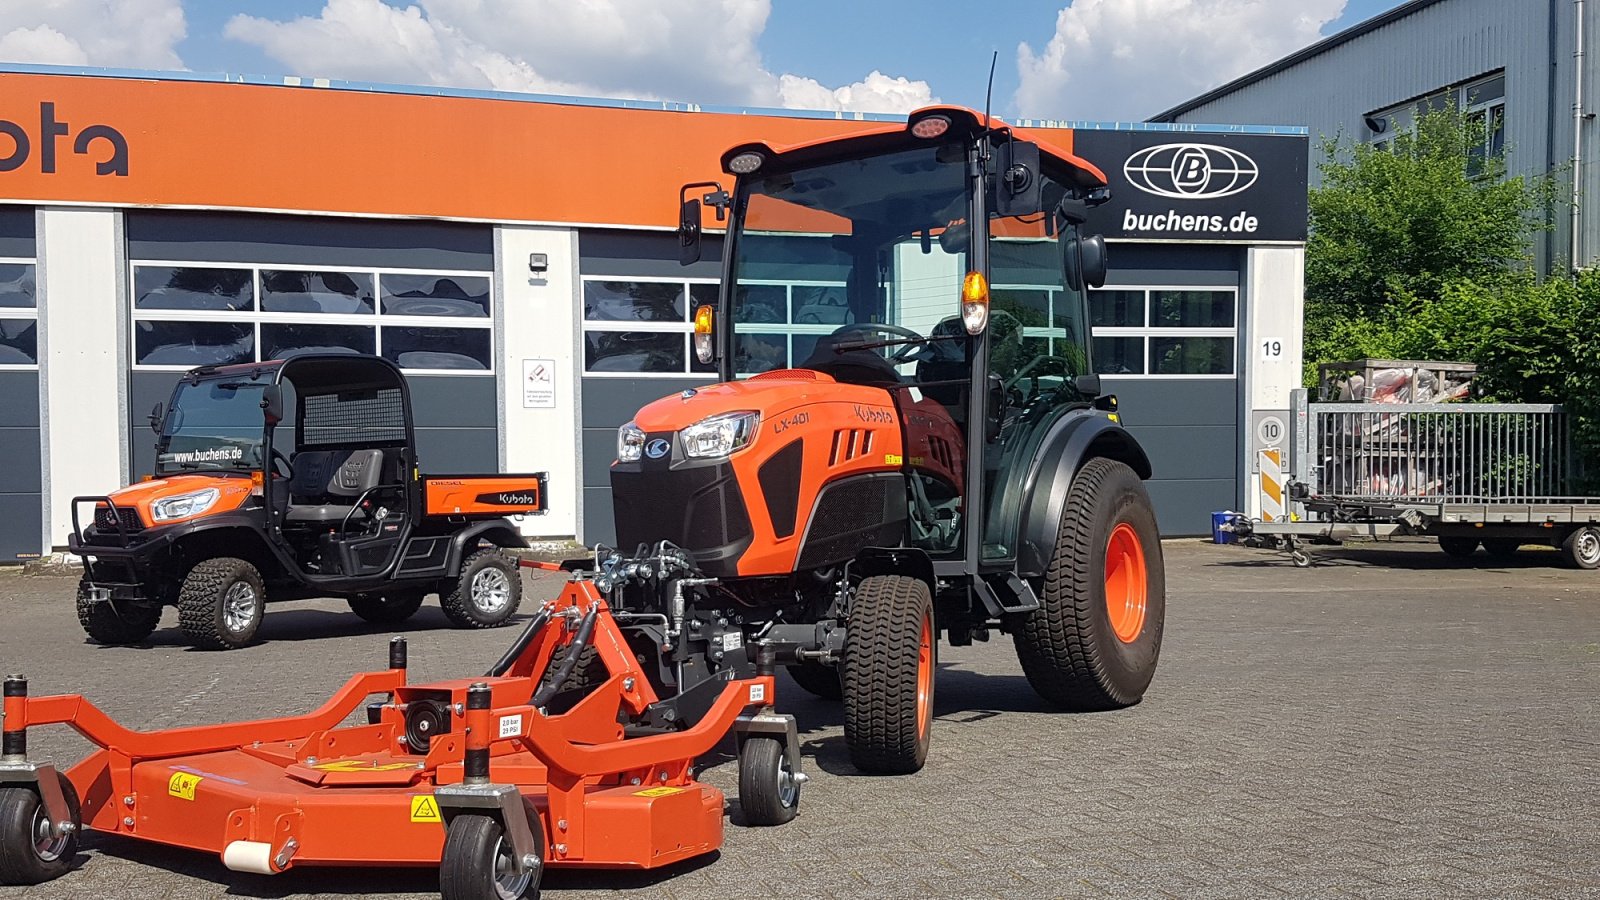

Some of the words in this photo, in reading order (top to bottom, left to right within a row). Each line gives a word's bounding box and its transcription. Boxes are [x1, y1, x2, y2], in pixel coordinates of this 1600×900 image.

[1122, 208, 1259, 233] buchens.de
[1262, 340, 1281, 357] 19
[853, 394, 894, 424] Kubota
[773, 412, 811, 434] LX-401
[1264, 423, 1279, 438] 10
[174, 446, 243, 463] www.buchens.de
[499, 493, 533, 505] Kubota
